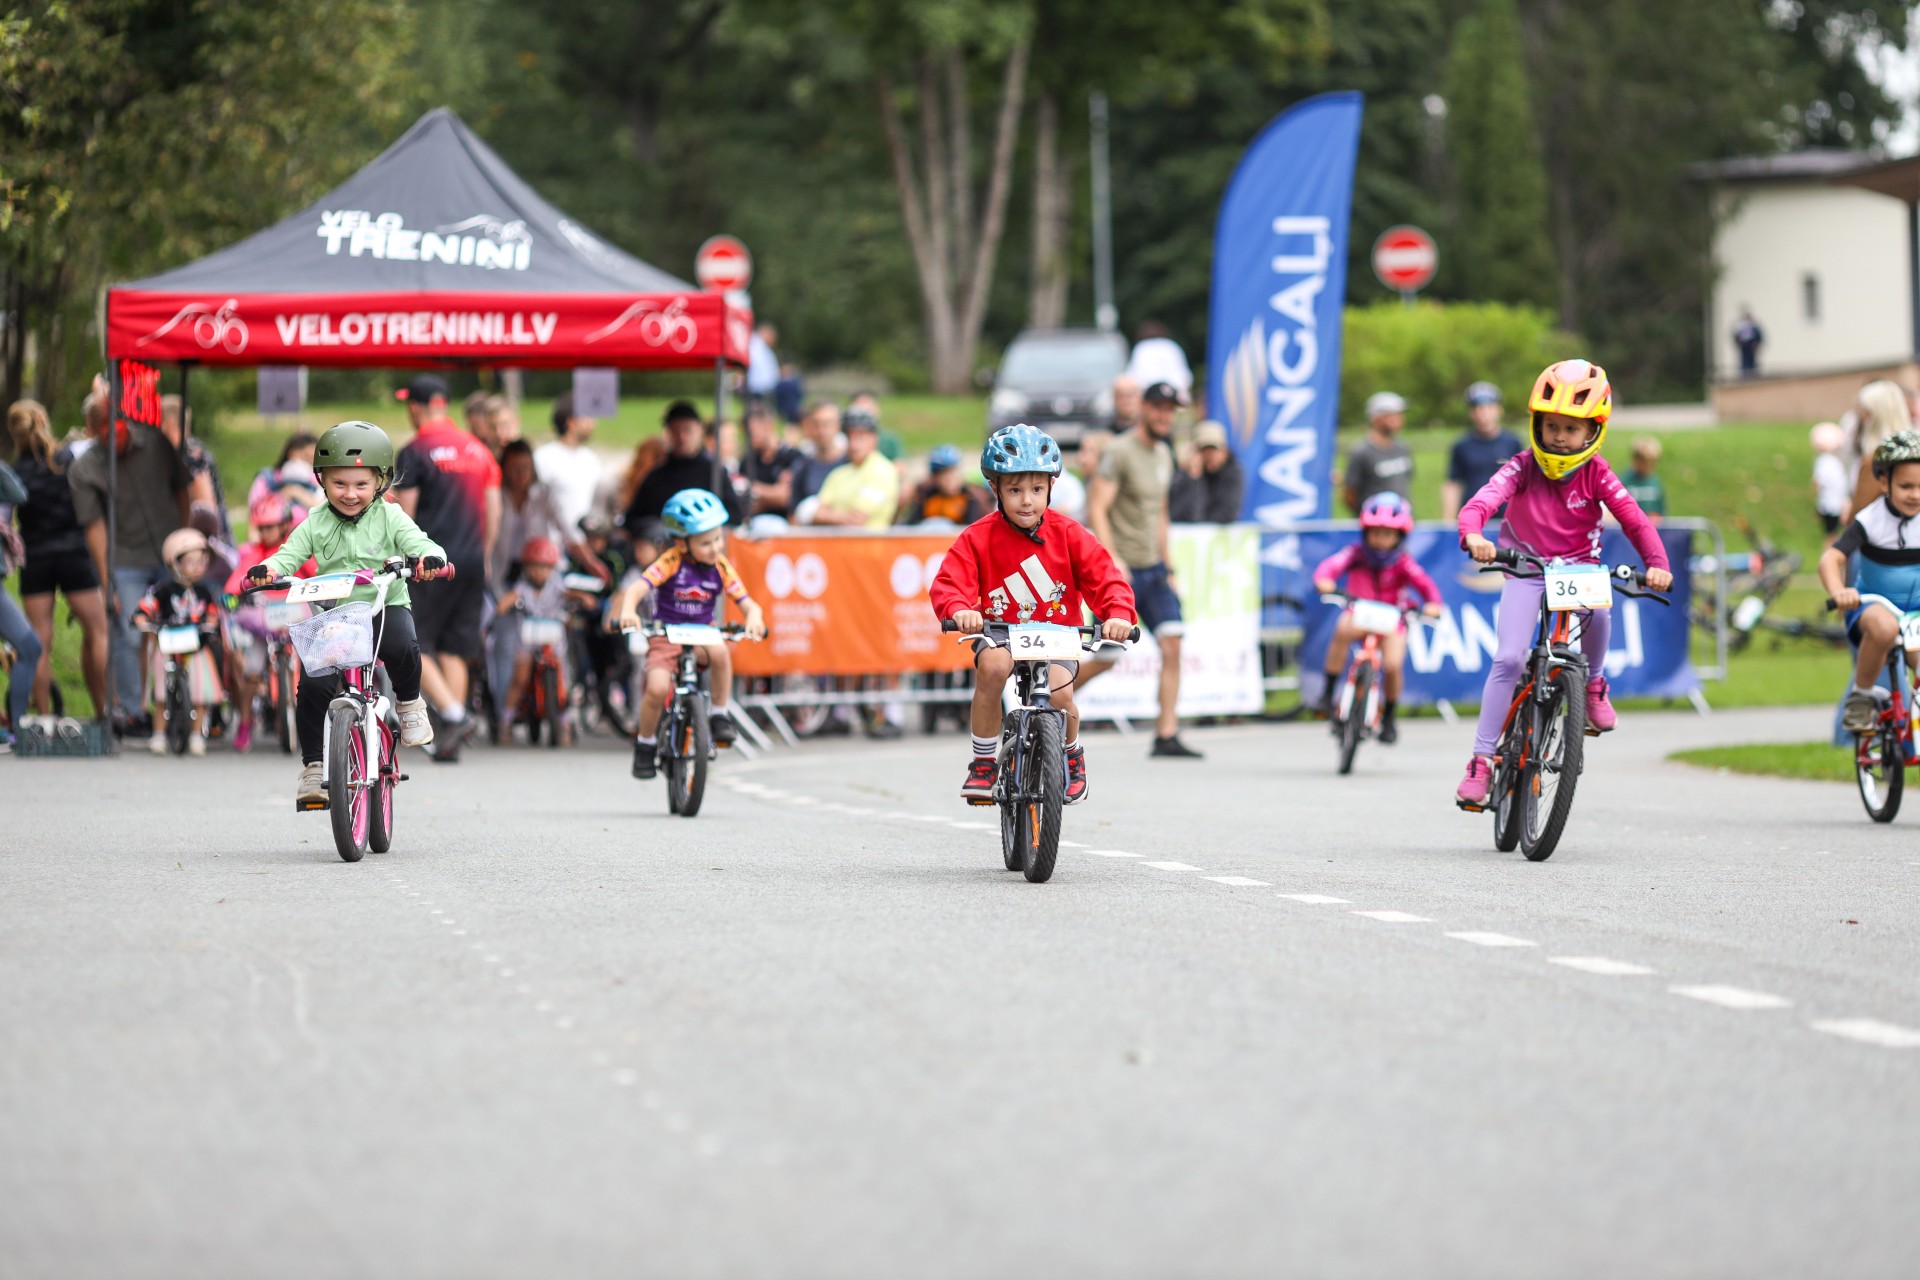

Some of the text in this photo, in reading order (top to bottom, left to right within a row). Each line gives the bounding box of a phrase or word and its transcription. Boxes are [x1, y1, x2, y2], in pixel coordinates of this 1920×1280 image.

[320, 210, 404, 232] VELO
[317, 227, 532, 272] TRENINI
[274, 311, 559, 346] VELOTRENINI.LV
[300, 584, 320, 595] 13
[1555, 580, 1578, 596] 36
[1019, 634, 1046, 649] 34
